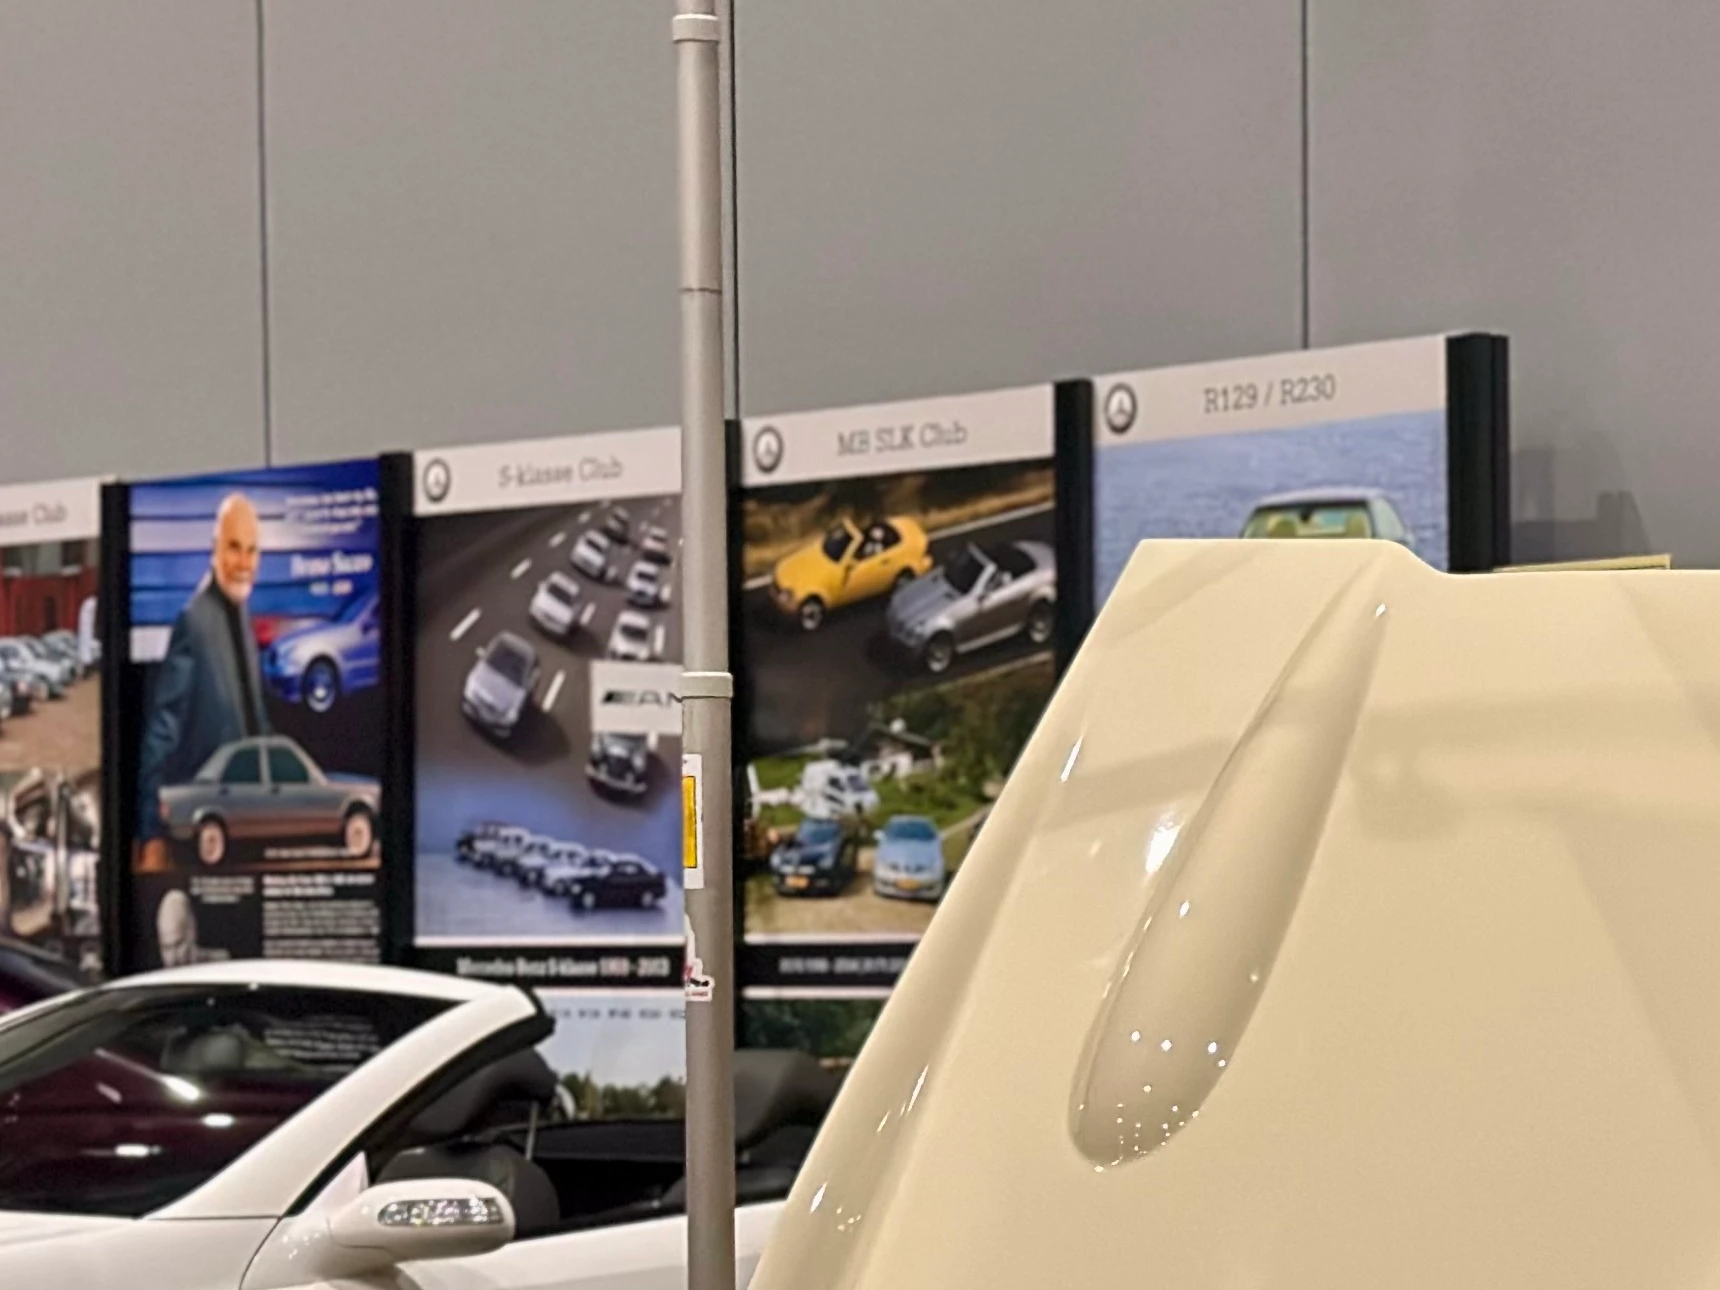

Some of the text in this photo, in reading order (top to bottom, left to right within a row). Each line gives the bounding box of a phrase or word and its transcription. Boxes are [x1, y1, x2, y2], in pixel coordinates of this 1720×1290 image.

[1203, 384, 1258, 414] R129
[1280, 374, 1337, 406] R230
[919, 421, 969, 448] Club
[578, 453, 624, 482] Club
